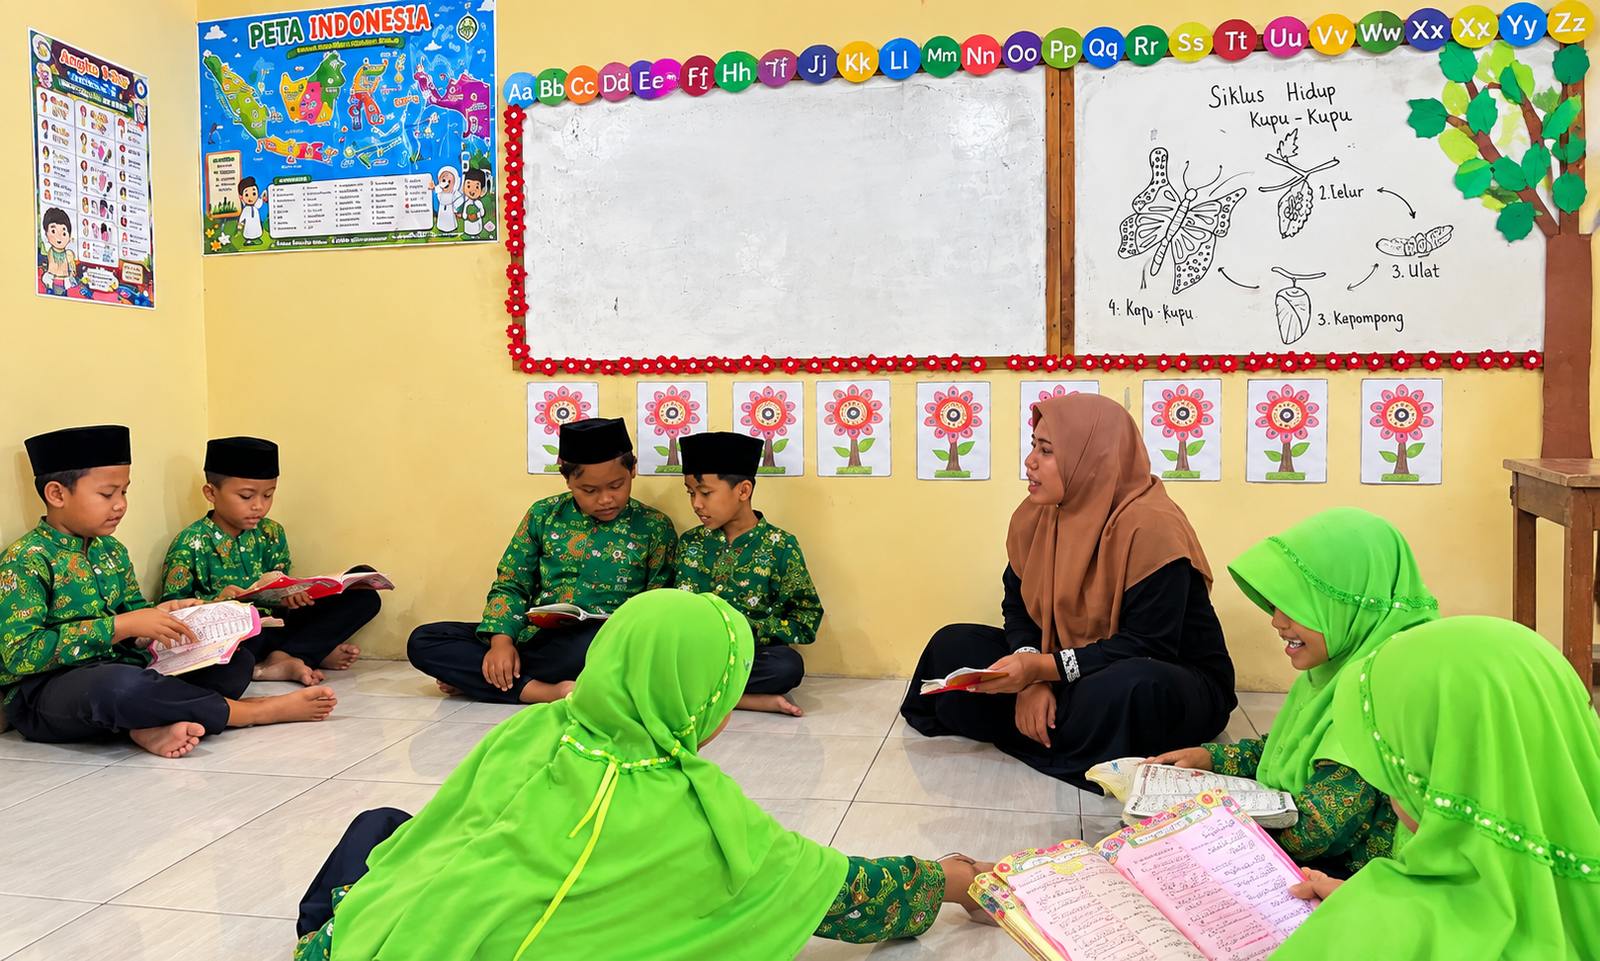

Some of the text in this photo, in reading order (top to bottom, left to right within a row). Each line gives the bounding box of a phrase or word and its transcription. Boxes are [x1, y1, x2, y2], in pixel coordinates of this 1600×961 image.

[249, 18, 305, 48] PETA
[309, 5, 431, 41] INDONESIA
[508, 83, 533, 102] Aa
[540, 79, 564, 98] Bb
[570, 76, 595, 96] Cc
[603, 73, 630, 93] Dd
[639, 71, 664, 90] Ee
[688, 66, 709, 90] Ff
[722, 61, 751, 83] Hh
[807, 54, 827, 77] Jj
[845, 52, 871, 75] Kk
[927, 47, 957, 63] Mm
[966, 46, 995, 66] Nn
[1007, 44, 1037, 63] Oo
[1050, 40, 1077, 63] Pp
[1089, 38, 1118, 61] Qq
[1134, 36, 1159, 56] Rr
[1177, 33, 1204, 52] Ss
[1224, 31, 1248, 51] Tt
[1270, 28, 1302, 48] Uu
[1316, 25, 1349, 46] Vv
[1360, 22, 1401, 43] Ww
[1412, 19, 1444, 40] Xx
[1458, 17, 1491, 41] Xx
[1506, 14, 1538, 40] Yy
[1554, 11, 1586, 33] Zz
[1208, 81, 1336, 109] Siklus Hidup
[1249, 111, 1290, 134] Kupu
[1306, 108, 1353, 132] Kupu
[1392, 261, 1440, 279] 3. Ulat
[1333, 310, 1404, 333] Kepompong
